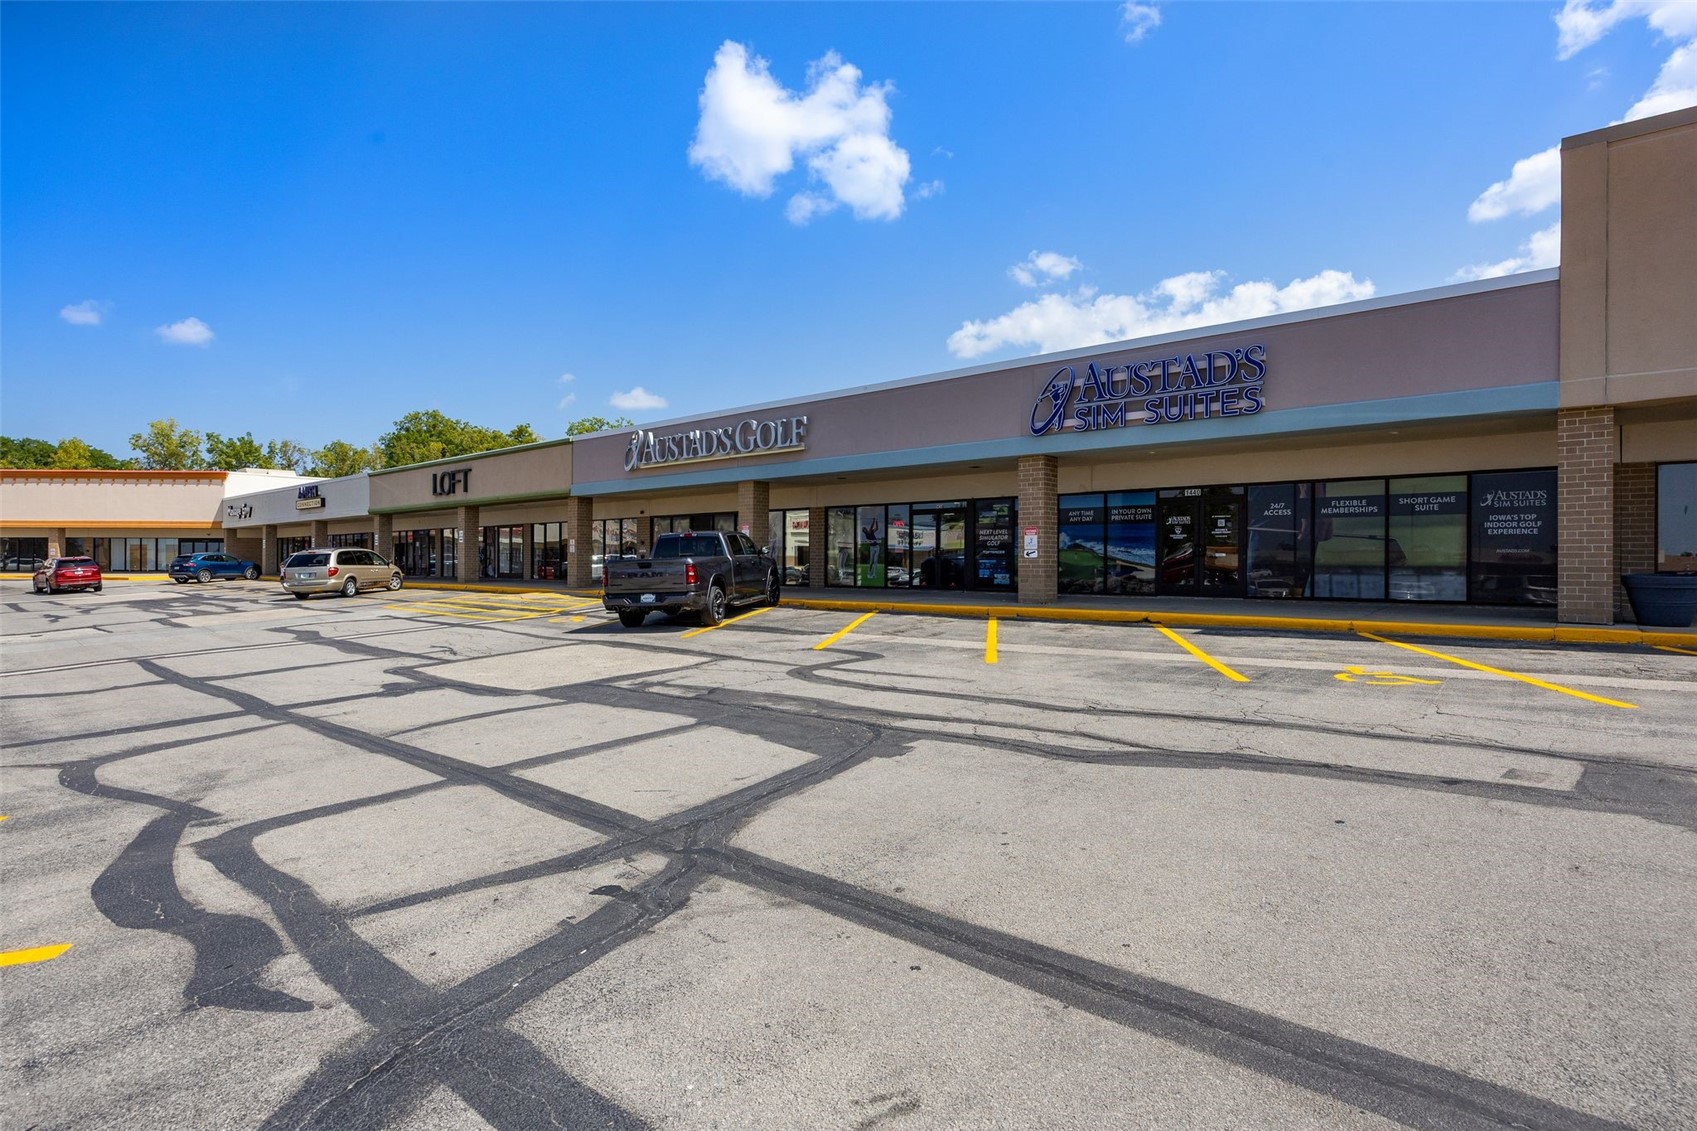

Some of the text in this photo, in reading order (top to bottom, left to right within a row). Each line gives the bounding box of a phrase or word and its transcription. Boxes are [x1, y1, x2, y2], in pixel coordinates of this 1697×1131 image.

[1073, 344, 1267, 404] AUSTAD'S
[1073, 386, 1264, 432] SIM SUITES
[641, 416, 808, 465] AUSTAD'S GOLF
[432, 468, 473, 496] LOFT
[1184, 488, 1202, 497] 1440
[1494, 490, 1547, 500] AUSTAD'S
[1331, 499, 1367, 507] FLEXIBLE
[1398, 495, 1456, 505] SHORT GAME
[1493, 499, 1547, 508] SIM SUITES
[1320, 506, 1378, 514] MEMBERSHIPS
